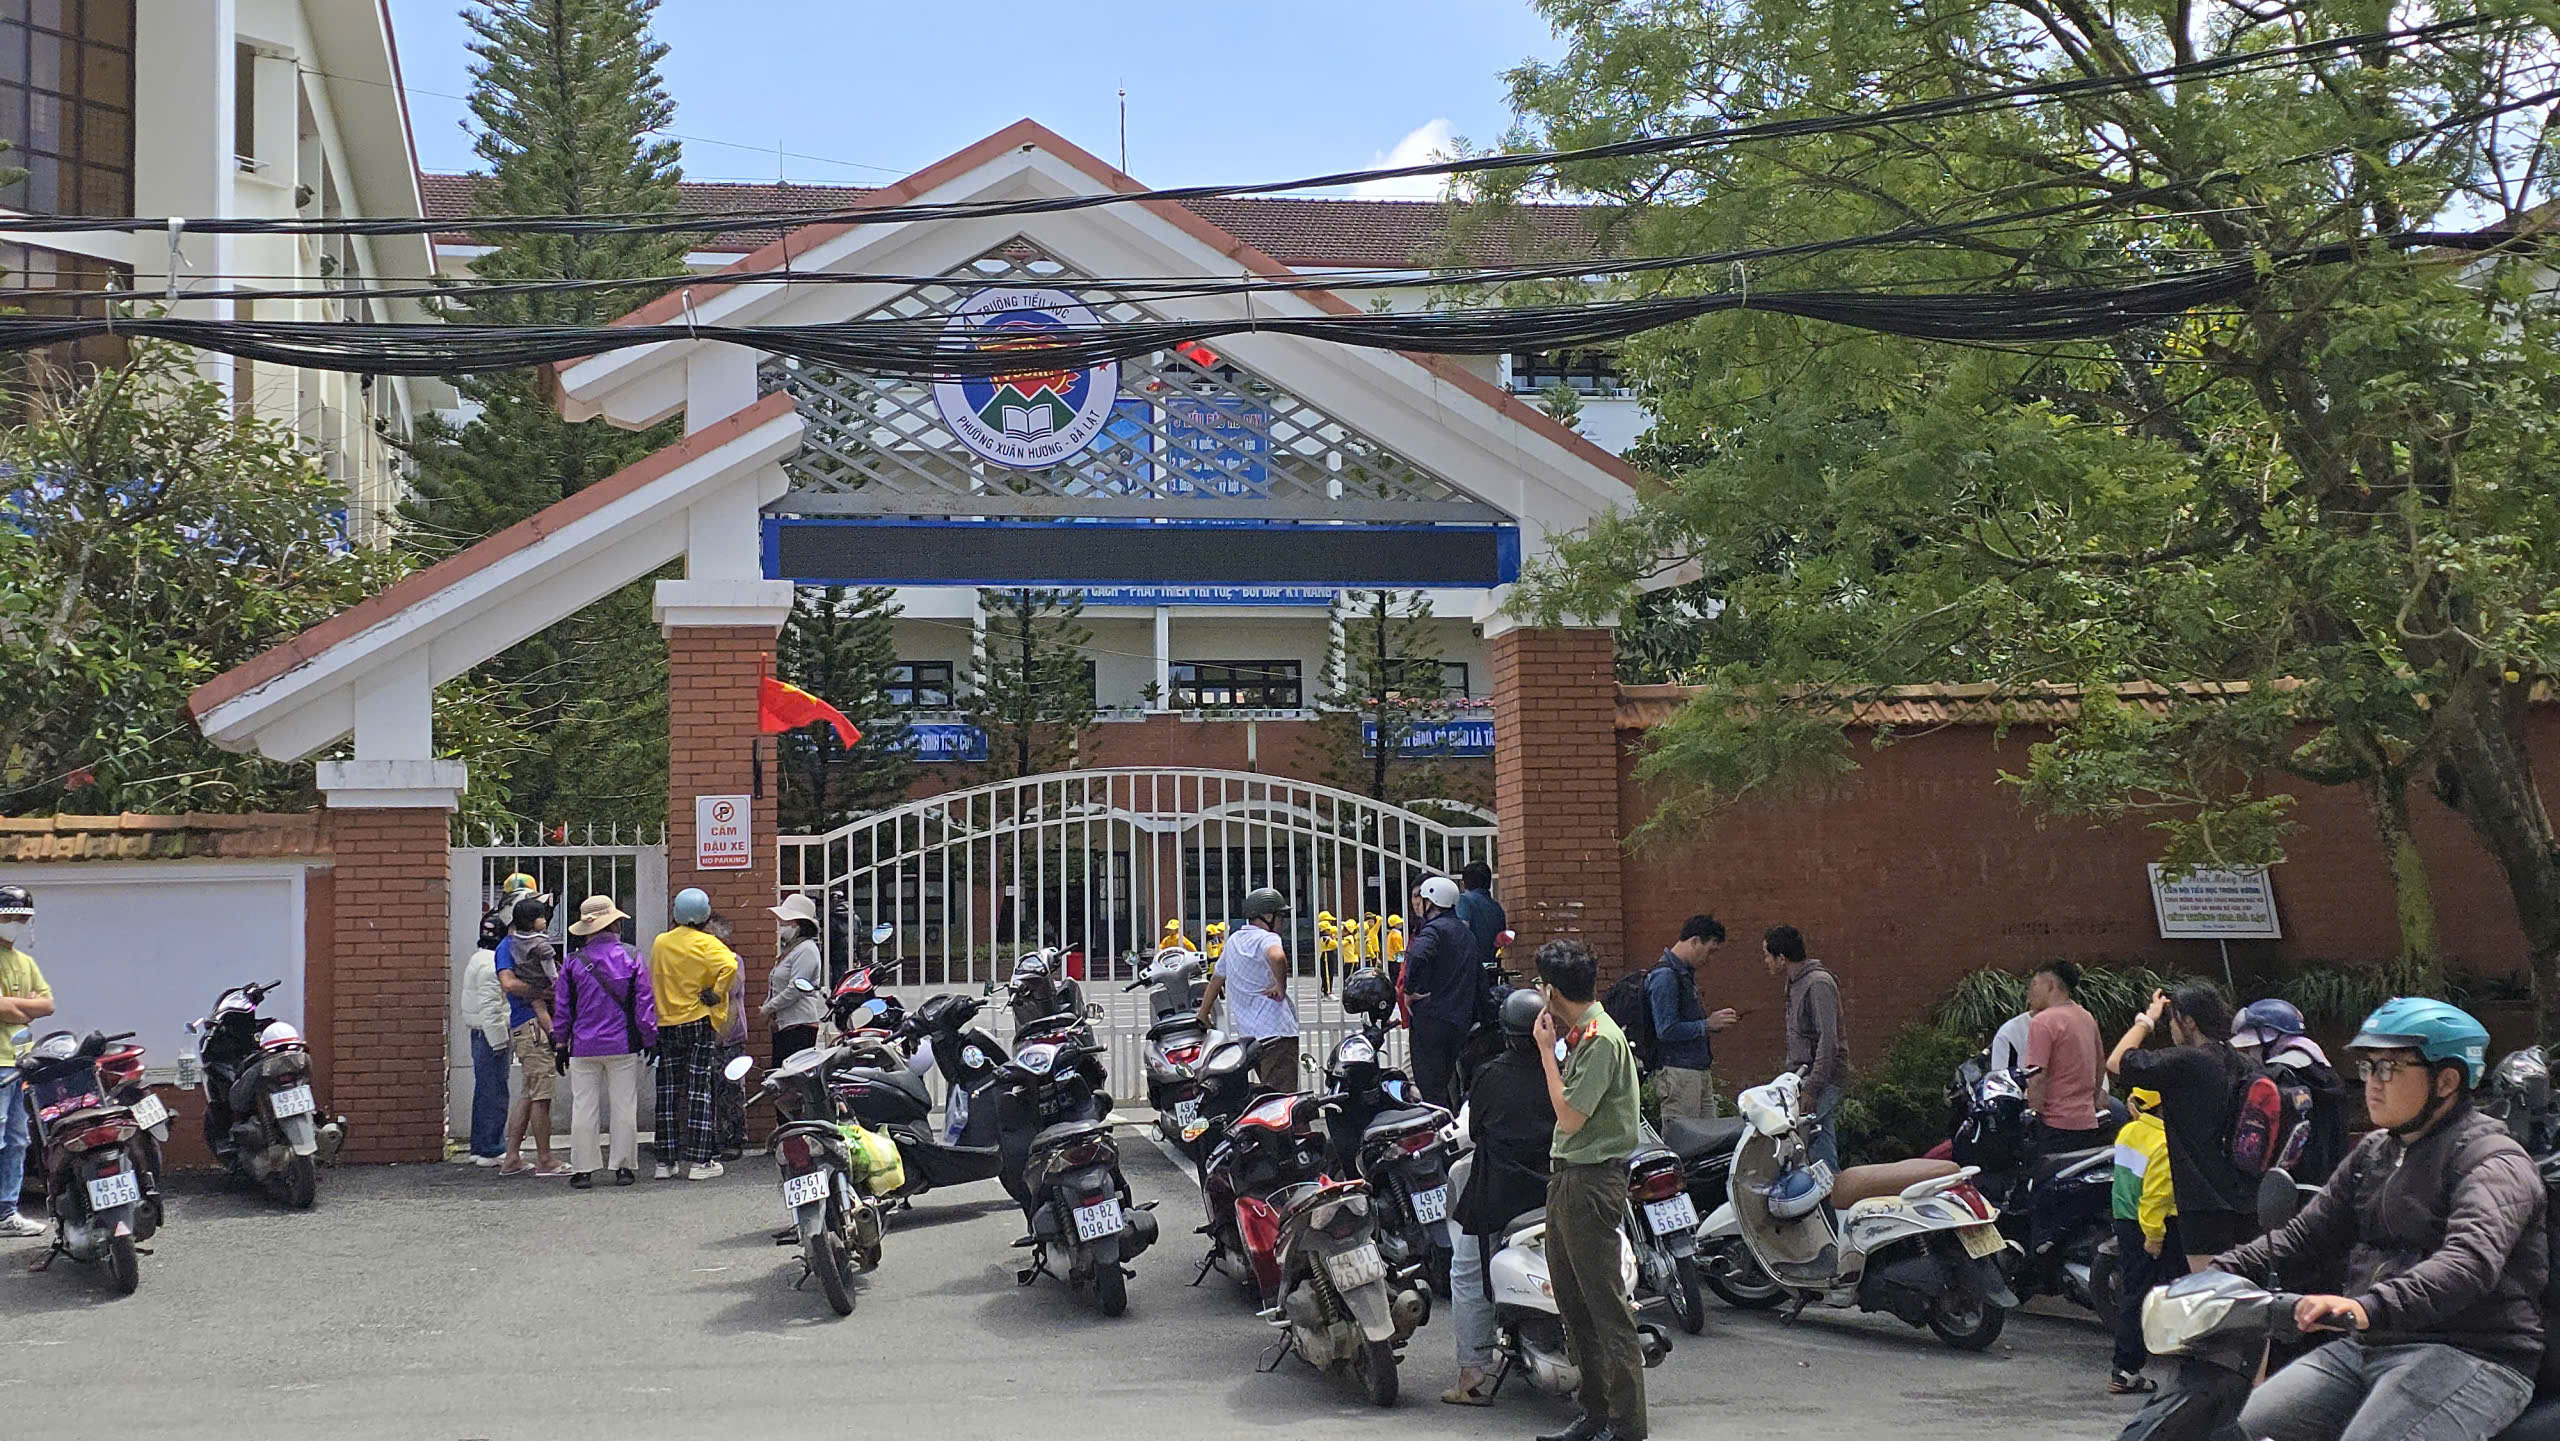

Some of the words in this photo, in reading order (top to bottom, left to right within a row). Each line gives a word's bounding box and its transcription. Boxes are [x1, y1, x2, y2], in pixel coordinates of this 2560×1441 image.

[956, 415, 994, 450] PHƯỜNG
[997, 443, 1025, 459] XUÂN
[1028, 441, 1063, 459] HƯƠNG
[1072, 428, 1086, 444] ĐÀ
[1083, 409, 1101, 432] LẠT
[730, 841, 745, 851] XE
[96, 1175, 128, 1192] 49-AC
[790, 1174, 820, 1191] 49-G1
[1082, 1203, 1113, 1222] 49-B2
[1657, 1211, 1691, 1231] 5656
